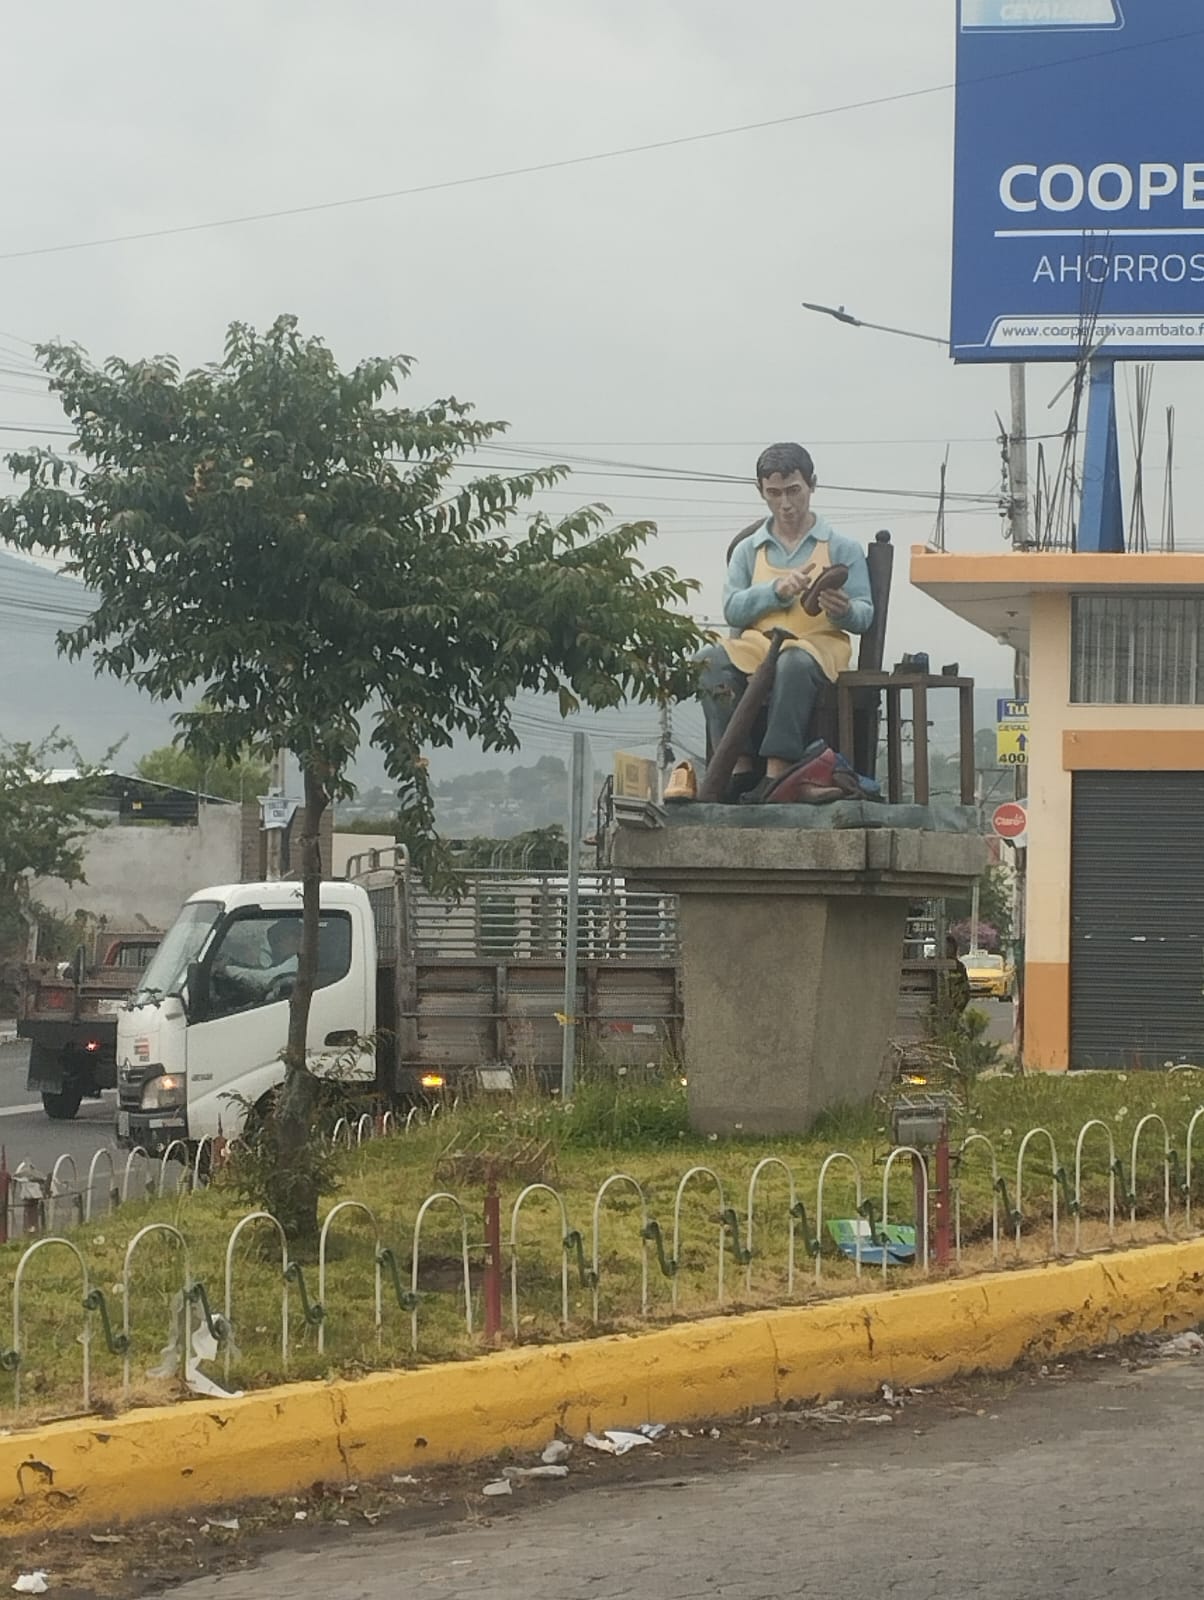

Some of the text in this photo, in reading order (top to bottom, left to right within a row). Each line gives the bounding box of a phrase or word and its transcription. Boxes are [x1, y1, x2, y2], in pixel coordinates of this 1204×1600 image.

[999, 163, 1204, 212] COOPE
[1033, 254, 1204, 283] AHORROS
[999, 753, 1028, 763] 400
